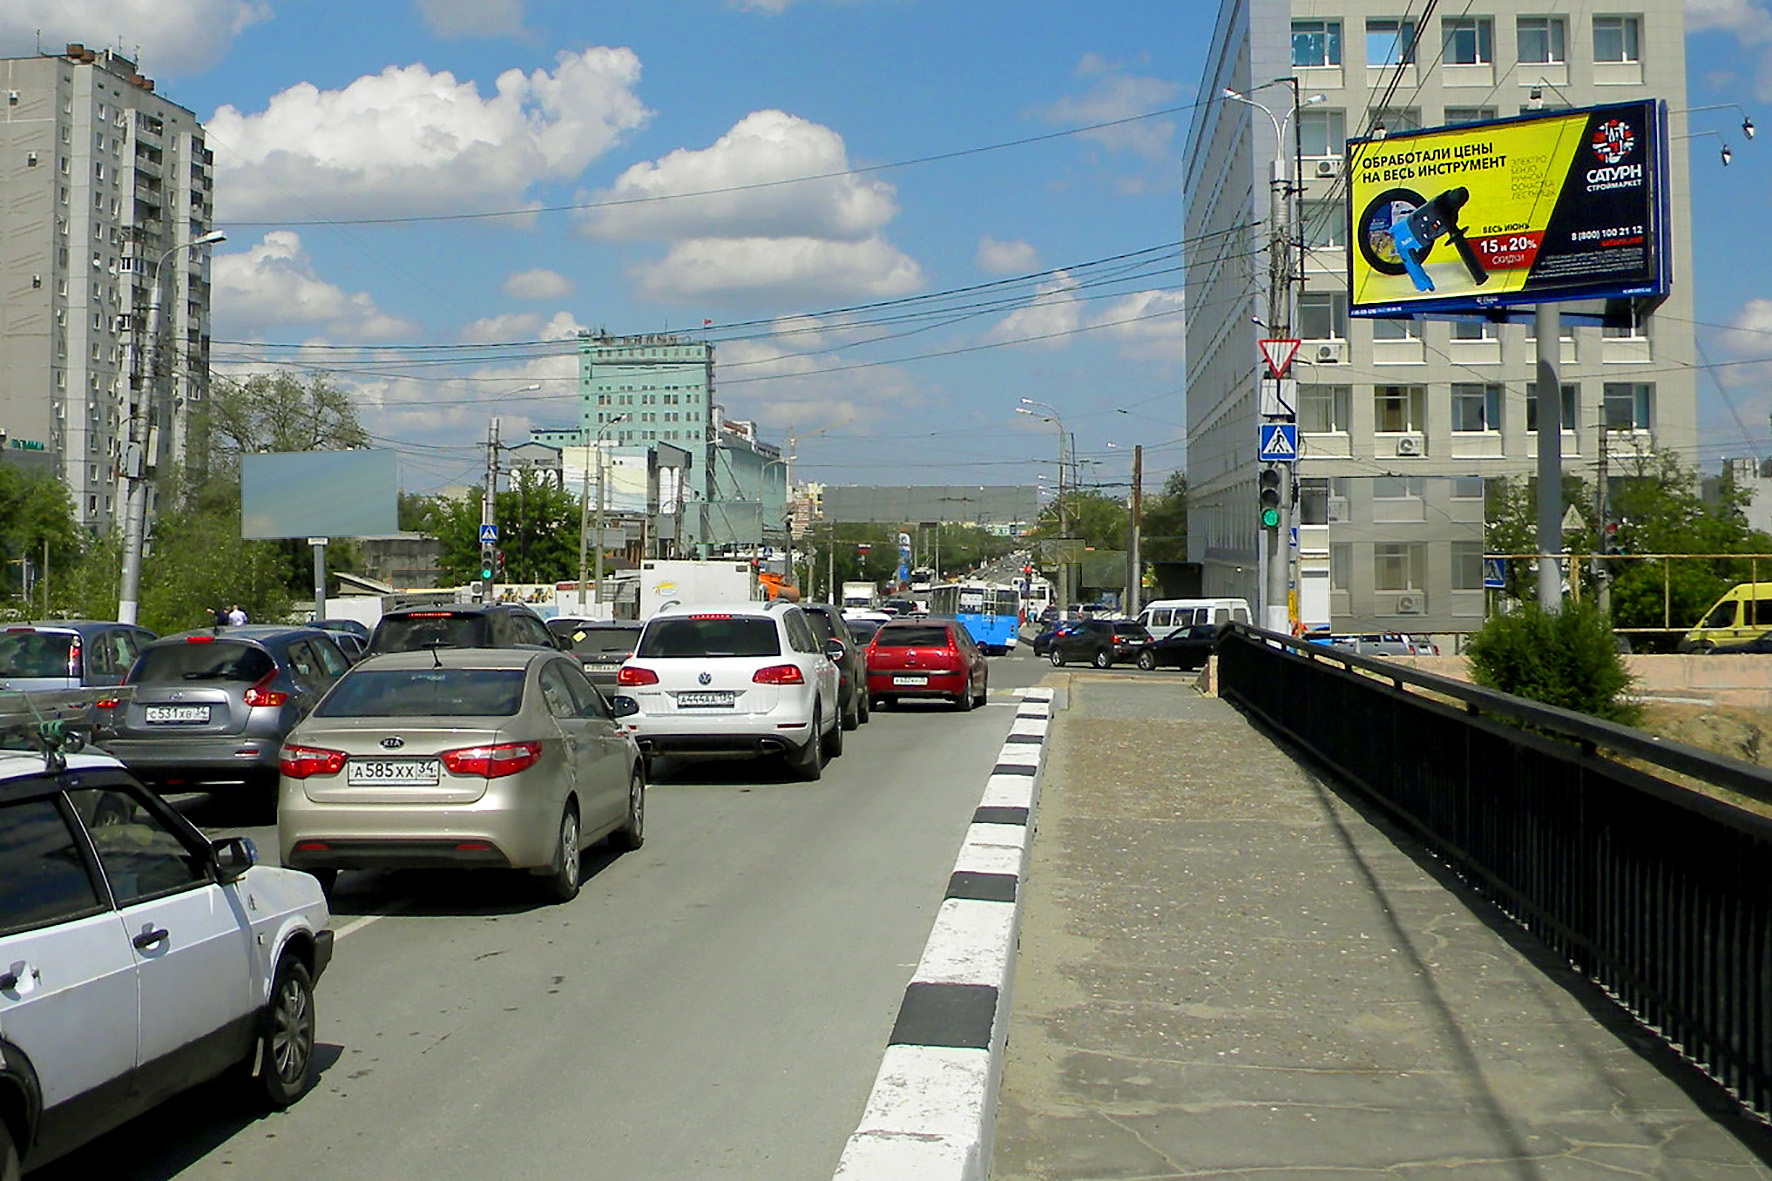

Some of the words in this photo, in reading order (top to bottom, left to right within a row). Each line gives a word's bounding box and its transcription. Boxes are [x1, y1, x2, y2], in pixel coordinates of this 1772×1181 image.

[1362, 147, 1450, 169] ОБРАБОТАЛИ
[1454, 142, 1493, 159] ЦЕНЫ
[1362, 172, 1381, 183] НА
[1383, 168, 1415, 182] ВЕСЬ
[1418, 155, 1507, 177] ИНСТРУМЕНТ
[1586, 164, 1642, 183] САТУРН
[1586, 179, 1642, 192] СТРОЙМАРКЕТ
[1483, 225, 1502, 234] ВЕСЬ
[1504, 222, 1530, 231] ИЮНЬ
[1571, 232, 1577, 241] 8
[1578, 230, 1600, 241] (800)
[1601, 228, 1617, 238] 100
[1619, 227, 1629, 236] 21
[1632, 225, 1643, 234] 12
[1480, 239, 1498, 253] 15
[1509, 236, 1537, 251] 20%
[383, 739, 401, 747] KIA
[418, 761, 434, 774] 34
